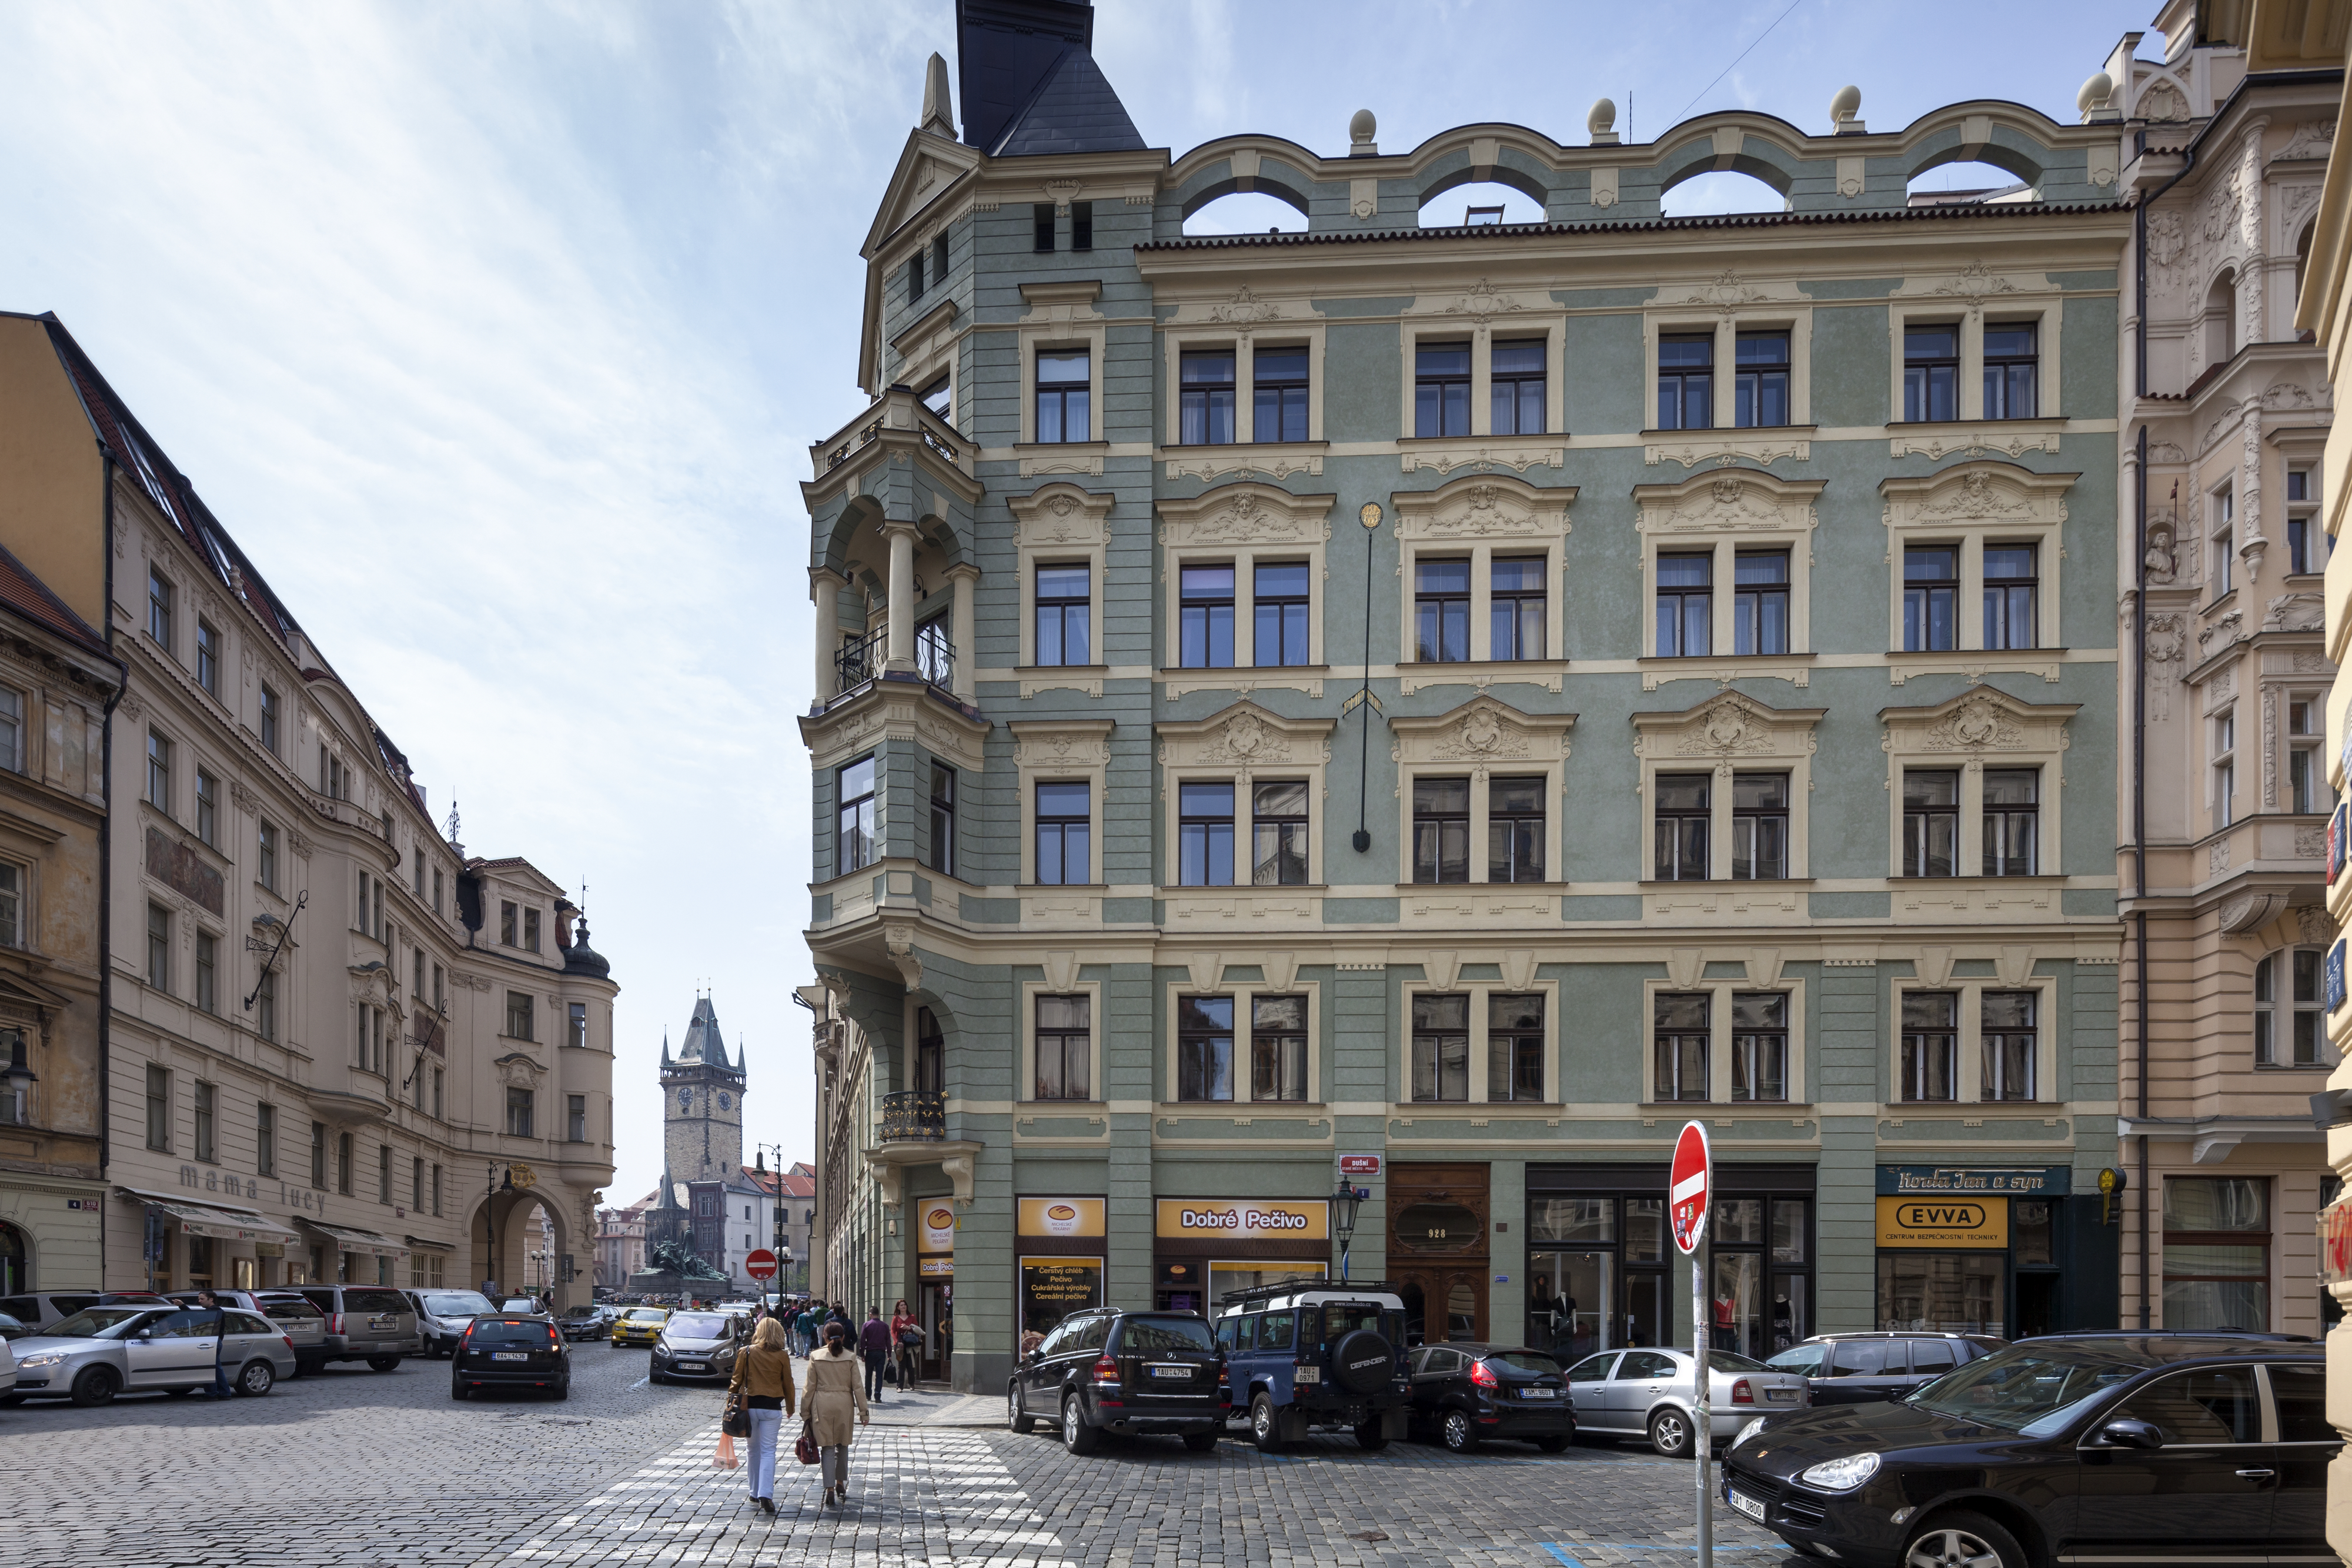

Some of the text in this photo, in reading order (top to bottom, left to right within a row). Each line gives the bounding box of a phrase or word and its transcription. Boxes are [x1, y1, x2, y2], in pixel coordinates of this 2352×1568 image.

[1955, 1172, 1988, 1189] Jan
[1993, 1176, 2006, 1189] a
[2010, 1175, 2046, 1192] syn
[181, 1165, 325, 1217] mama lucy
[1182, 1210, 1307, 1229] Dobré Pečivo
[1912, 1208, 1972, 1223] EVVA
[1428, 1229, 1446, 1238] 928
[1917, 1232, 1964, 1240] BEZPEČNOSTNÍ
[1038, 1266, 1064, 1275] Čerstvý
[1065, 1284, 1091, 1292] výrobky
[1349, 1356, 1388, 1370] DEFENDER
[1732, 1492, 1761, 1516] 6A1 0800
